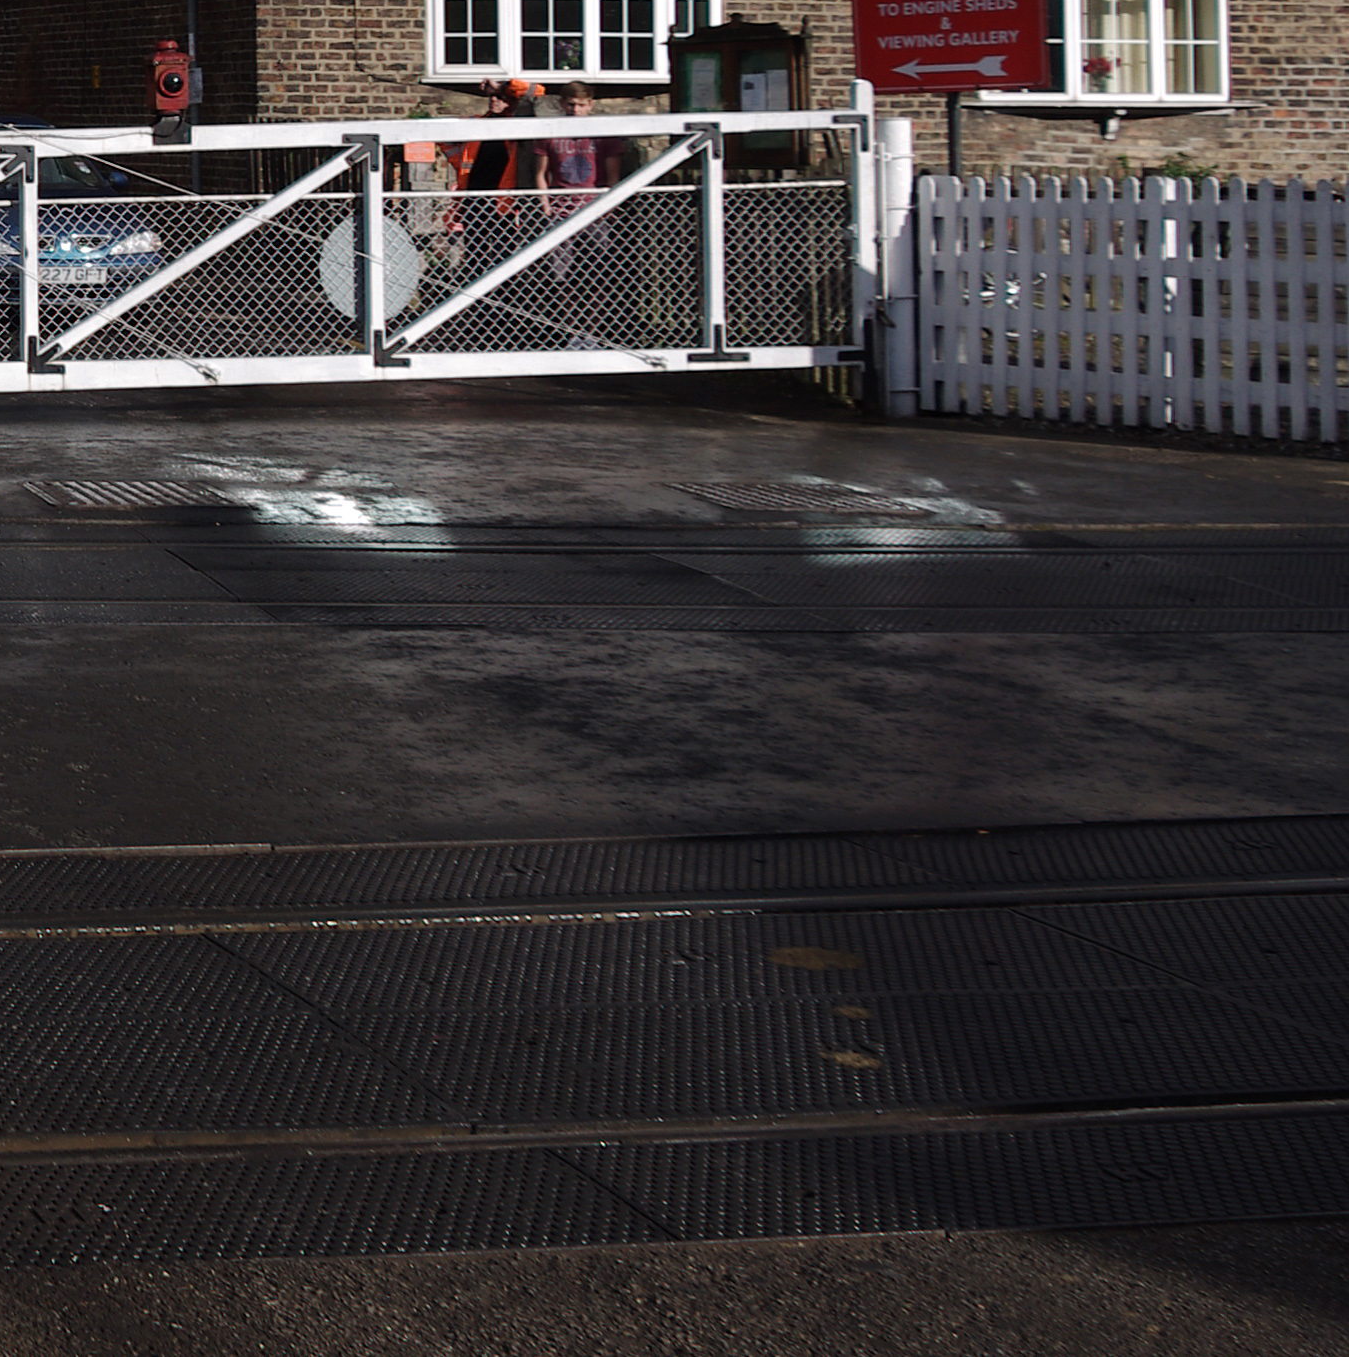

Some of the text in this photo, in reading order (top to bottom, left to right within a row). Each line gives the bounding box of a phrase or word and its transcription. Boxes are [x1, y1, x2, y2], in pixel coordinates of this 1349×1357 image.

[878, 3, 900, 17] TO
[903, 0, 962, 15] ENGINE
[939, 17, 952, 30] &
[878, 30, 1020, 49] VIEWING GALLERY
[39, 268, 105, 281] 227 GFT
